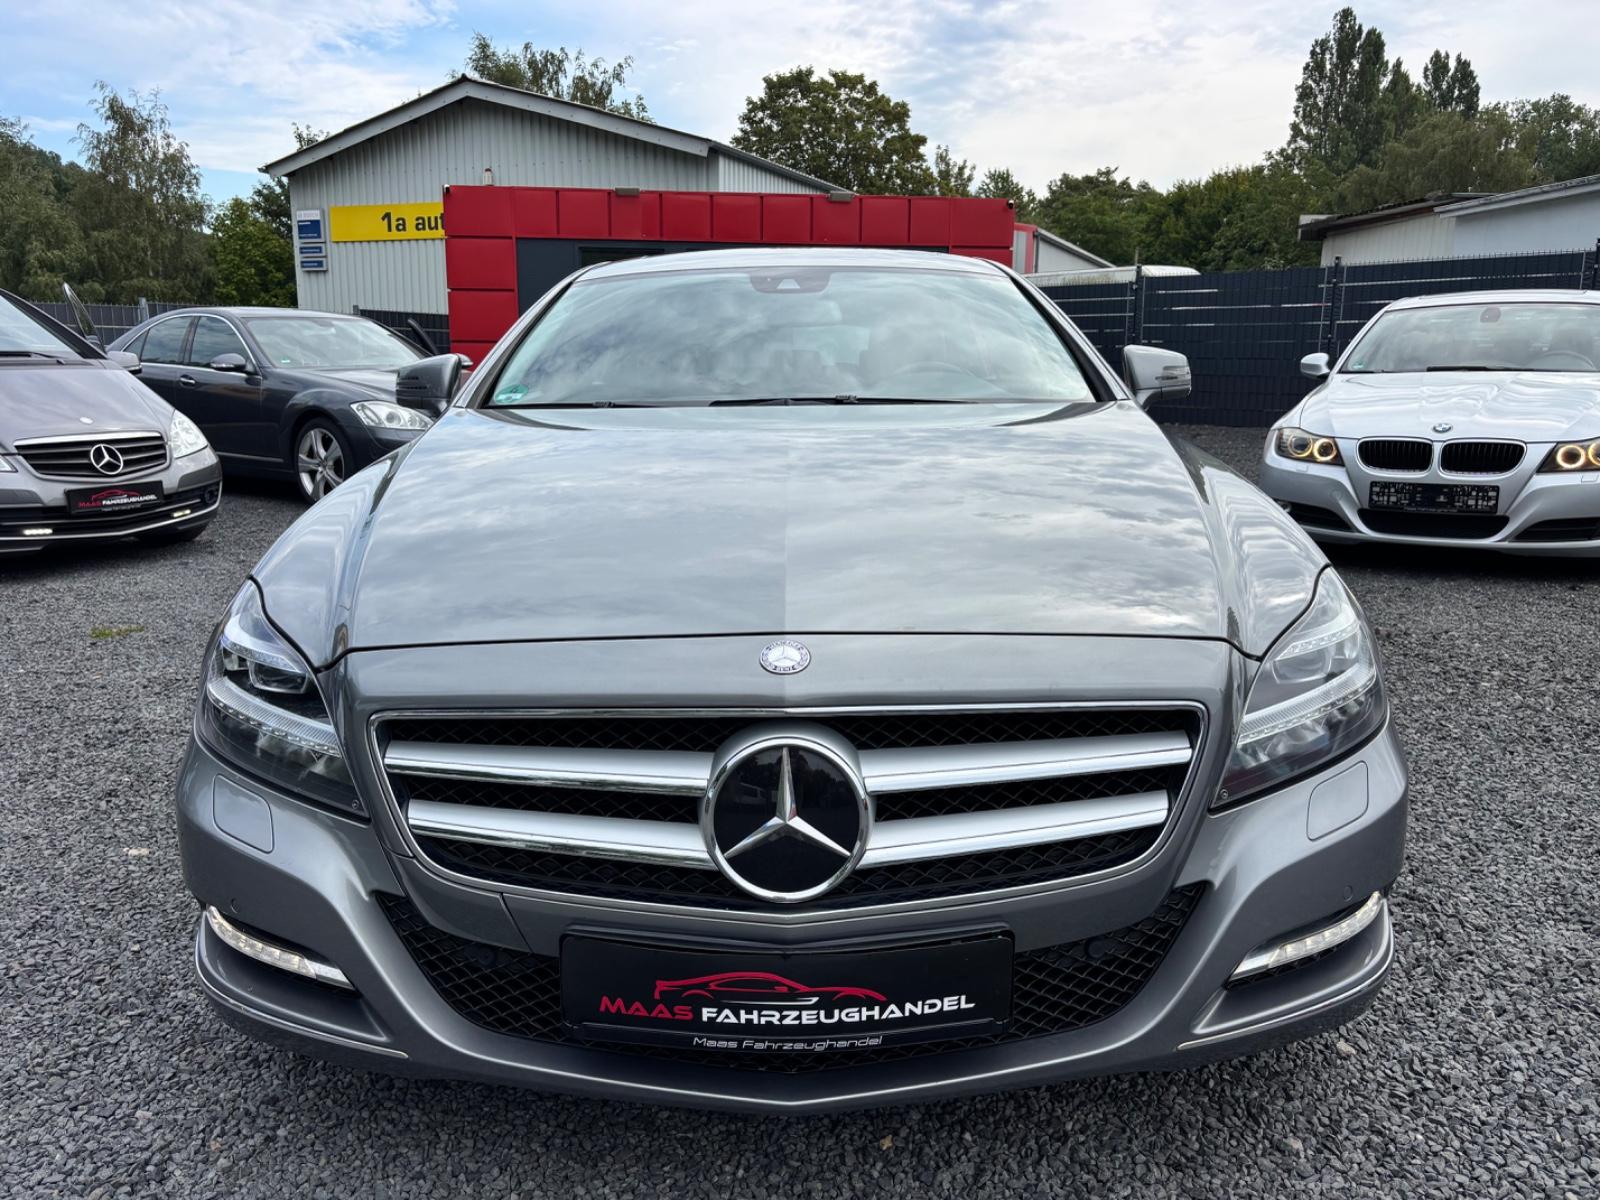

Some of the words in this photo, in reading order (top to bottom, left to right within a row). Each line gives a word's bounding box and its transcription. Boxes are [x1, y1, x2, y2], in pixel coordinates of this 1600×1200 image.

[381, 212, 407, 232] 1a
[600, 995, 694, 1021] MAAS
[701, 994, 976, 1025] FAHRZEUGHANDEL
[692, 1036, 738, 1048] Maas
[742, 1035, 883, 1051] Fahrzeughandel
